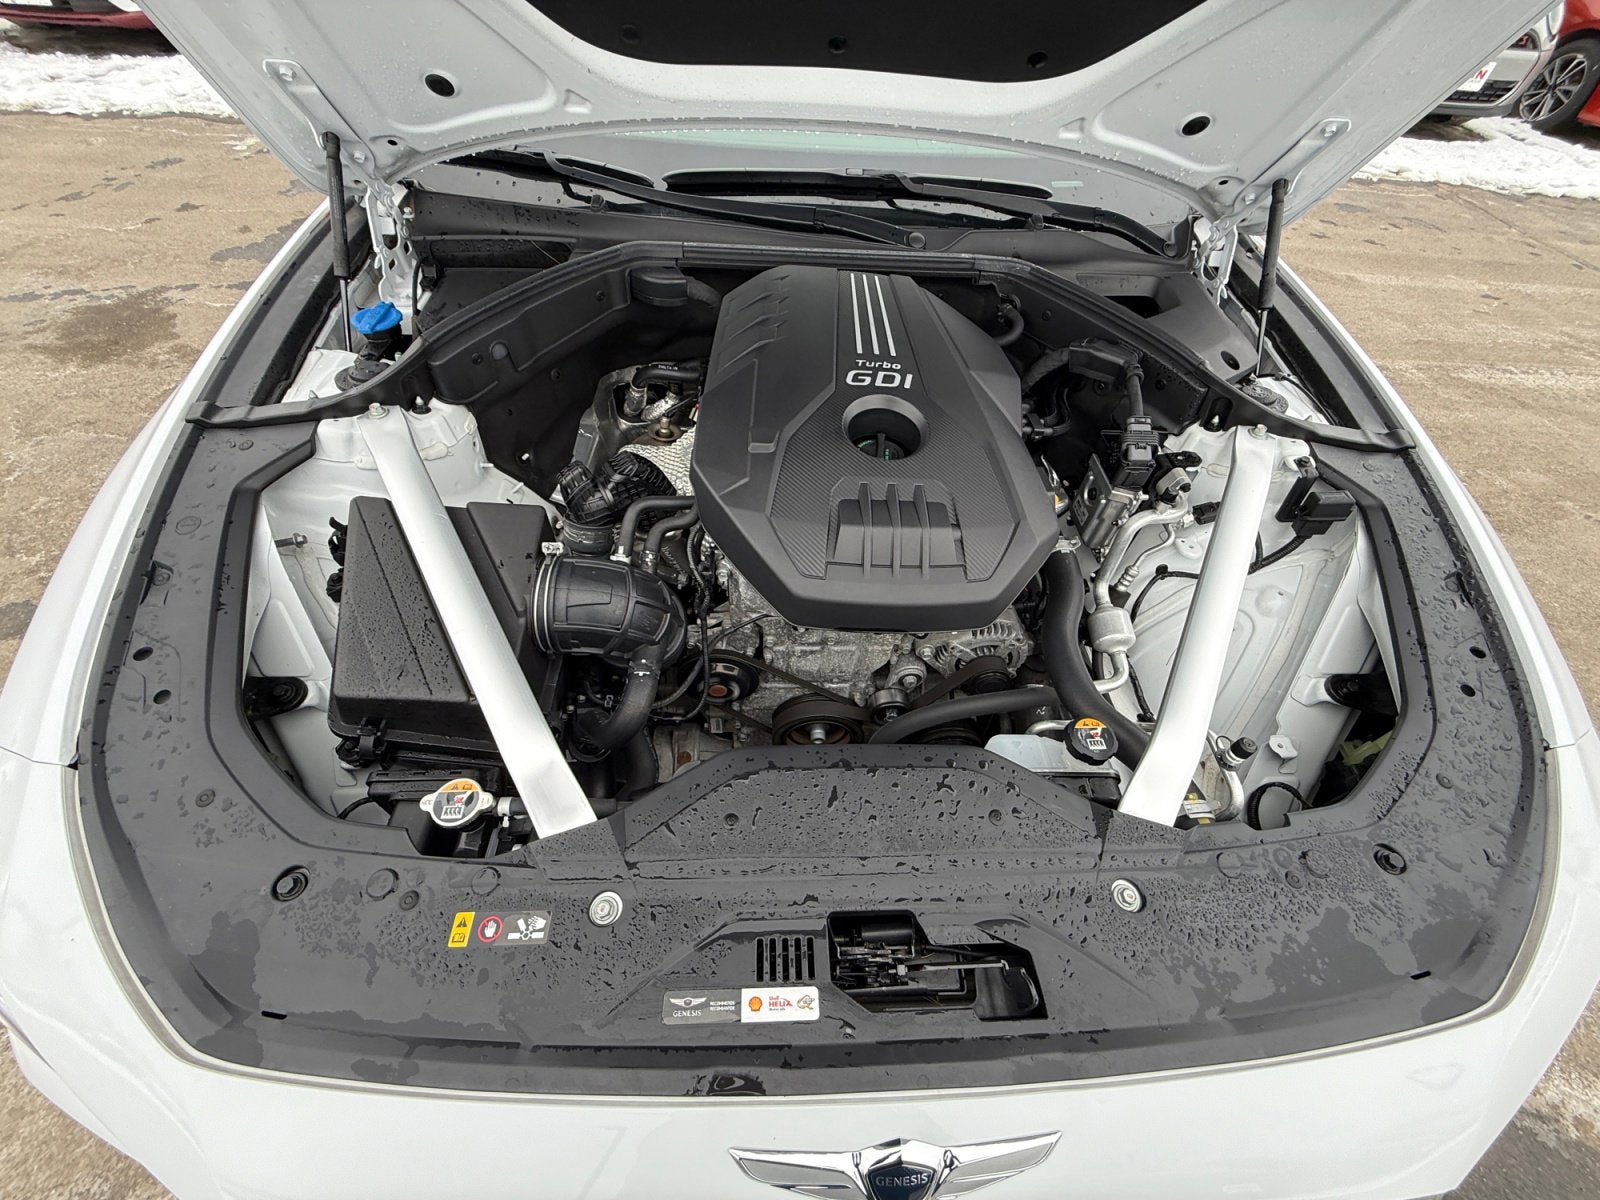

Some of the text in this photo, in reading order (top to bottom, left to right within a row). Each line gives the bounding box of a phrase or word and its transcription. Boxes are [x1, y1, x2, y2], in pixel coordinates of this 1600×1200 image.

[855, 359, 902, 370] Turbo
[845, 369, 913, 389] GDI
[768, 1000, 793, 1008] HELIX
[672, 1009, 702, 1018] GENESIS
[875, 1172, 929, 1188] GENESIS
